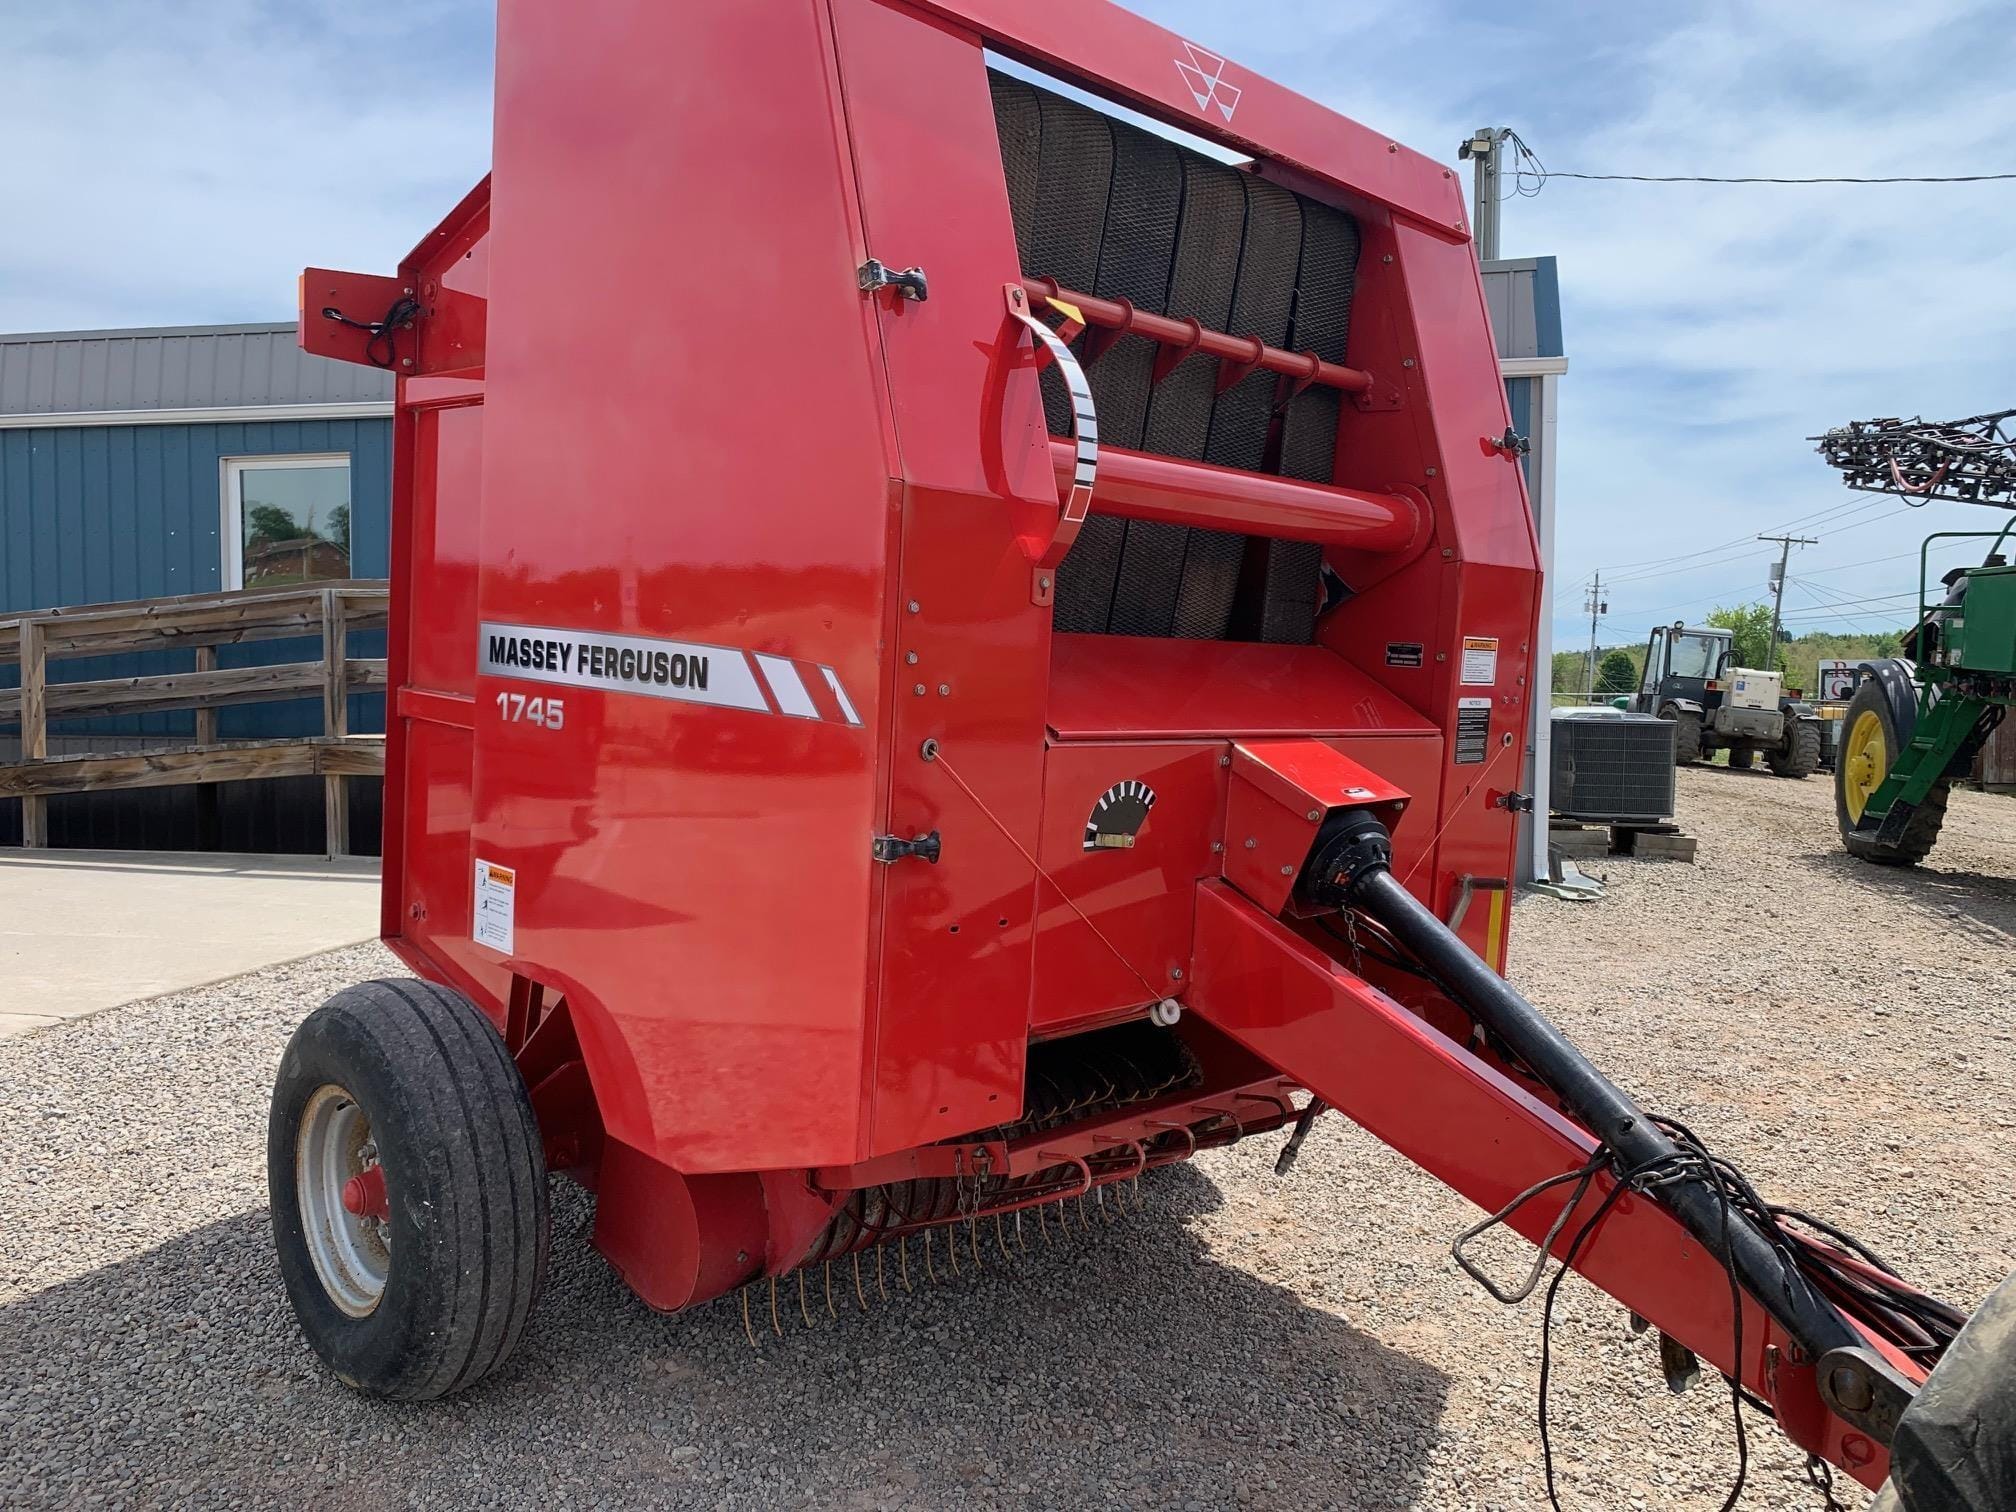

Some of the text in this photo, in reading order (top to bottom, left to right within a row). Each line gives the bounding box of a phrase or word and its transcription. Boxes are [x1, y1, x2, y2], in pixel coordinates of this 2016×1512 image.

[489, 635, 708, 692] MASSEY FERGUSON
[496, 691, 564, 730] 1745
[492, 871, 513, 884] WARNING
